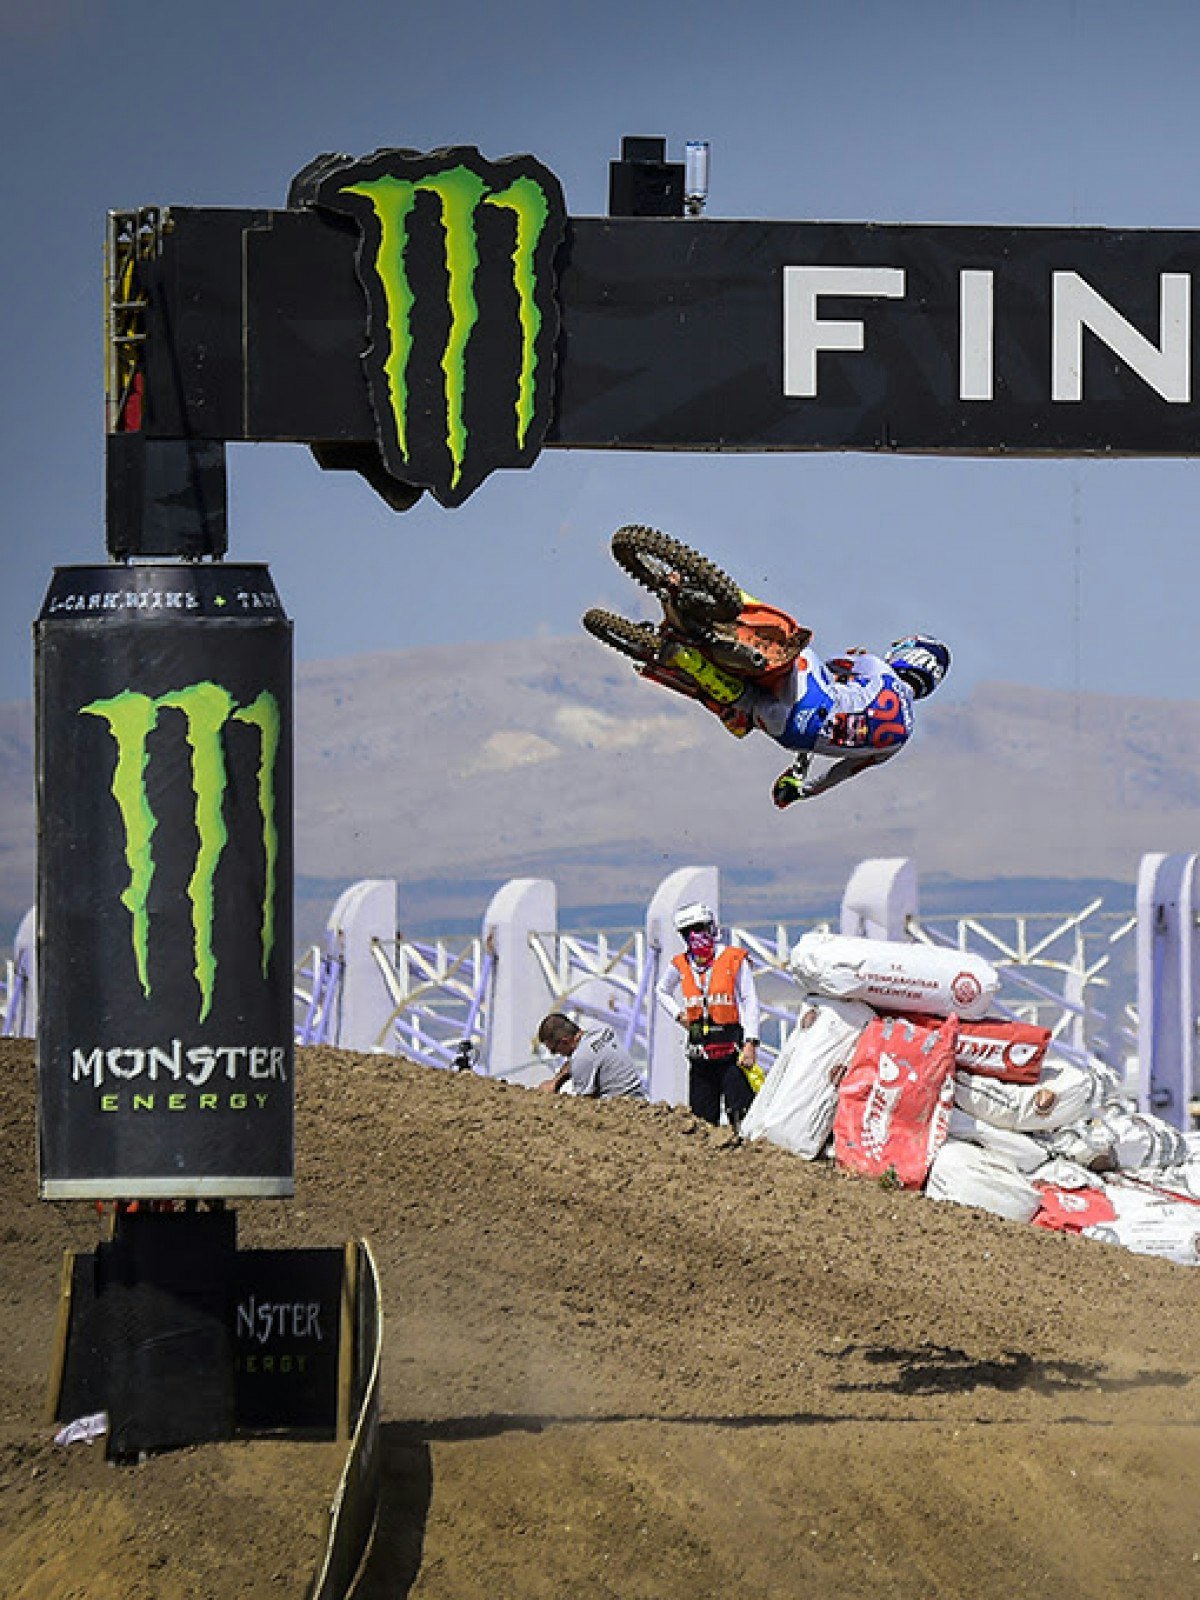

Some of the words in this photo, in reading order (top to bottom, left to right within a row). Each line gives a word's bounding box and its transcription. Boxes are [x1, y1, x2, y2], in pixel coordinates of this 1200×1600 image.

[72, 1040, 287, 1087] MONSTER
[101, 1093, 268, 1111] ENERGY
[237, 1295, 323, 1344] NSTER
